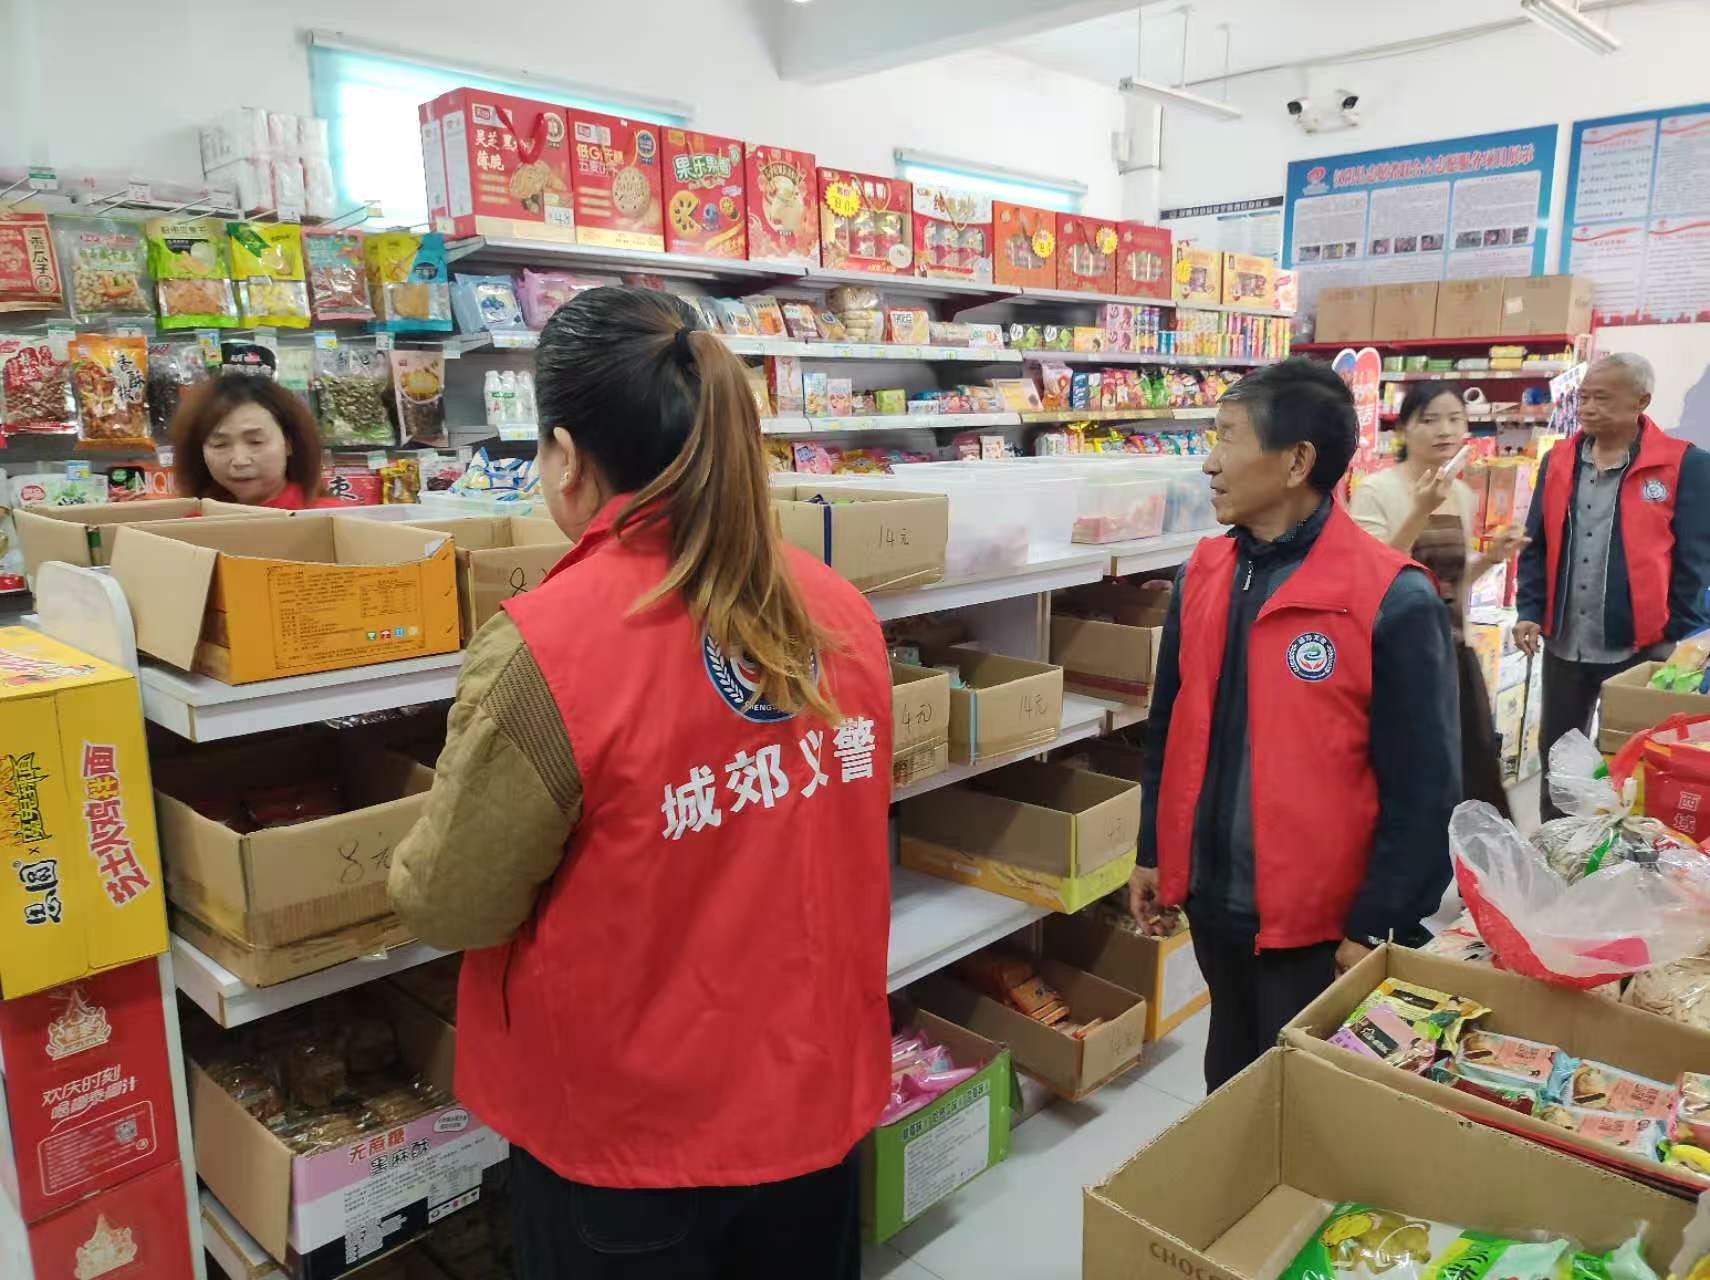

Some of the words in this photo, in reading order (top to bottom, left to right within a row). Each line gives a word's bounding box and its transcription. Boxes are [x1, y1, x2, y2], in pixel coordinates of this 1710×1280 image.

[878, 524, 912, 549] 14元
[661, 716, 877, 840] 城郊义警
[83, 741, 150, 905] 芝士火鸡拌面
[41, 1064, 121, 1107] 欢庆时刻
[348, 1126, 406, 1164] 无蔗糖
